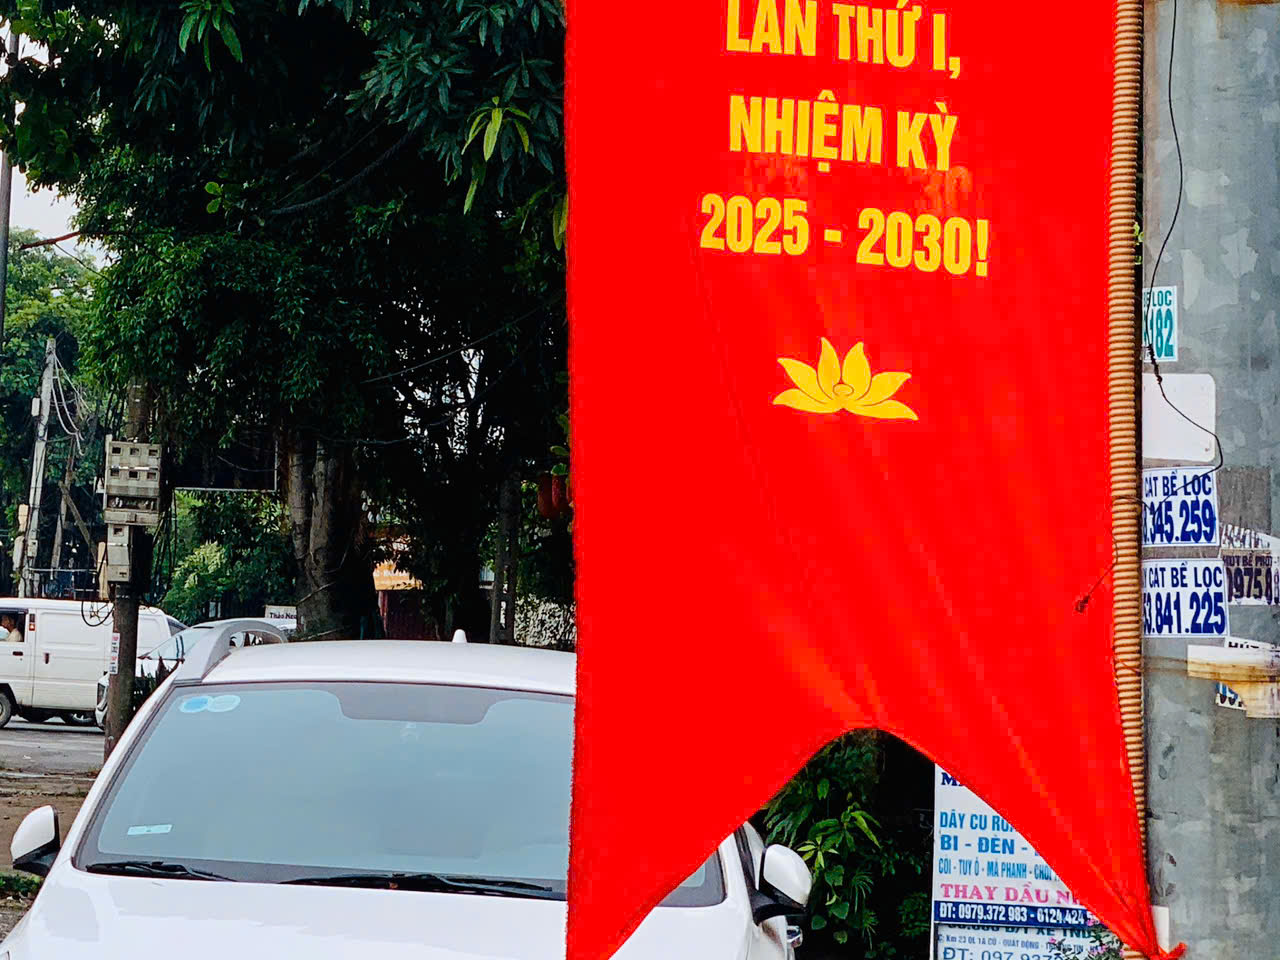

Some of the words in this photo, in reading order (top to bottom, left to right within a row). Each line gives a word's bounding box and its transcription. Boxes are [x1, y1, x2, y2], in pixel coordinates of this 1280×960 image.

[932, 13, 960, 78] I,
[729, 89, 882, 172] NHIỆM
[897, 102, 957, 172] KỲ
[700, 193, 809, 255] 2025
[824, 228, 841, 242] -
[856, 207, 989, 277] 2030!
[1149, 564, 1166, 588] CÁT
[1170, 561, 1188, 588] BỂ
[940, 809, 965, 829] DÂY
[970, 814, 987, 830] CU
[992, 815, 1013, 832] RO
[940, 834, 958, 851] BI
[977, 834, 1015, 854] ĐÈN
[958, 859, 972, 875] TUY
[1001, 862, 1027, 879] PHANH
[940, 883, 998, 900] THAY
[1004, 881, 1049, 903] DẦU
[939, 902, 956, 918] ĐT:
